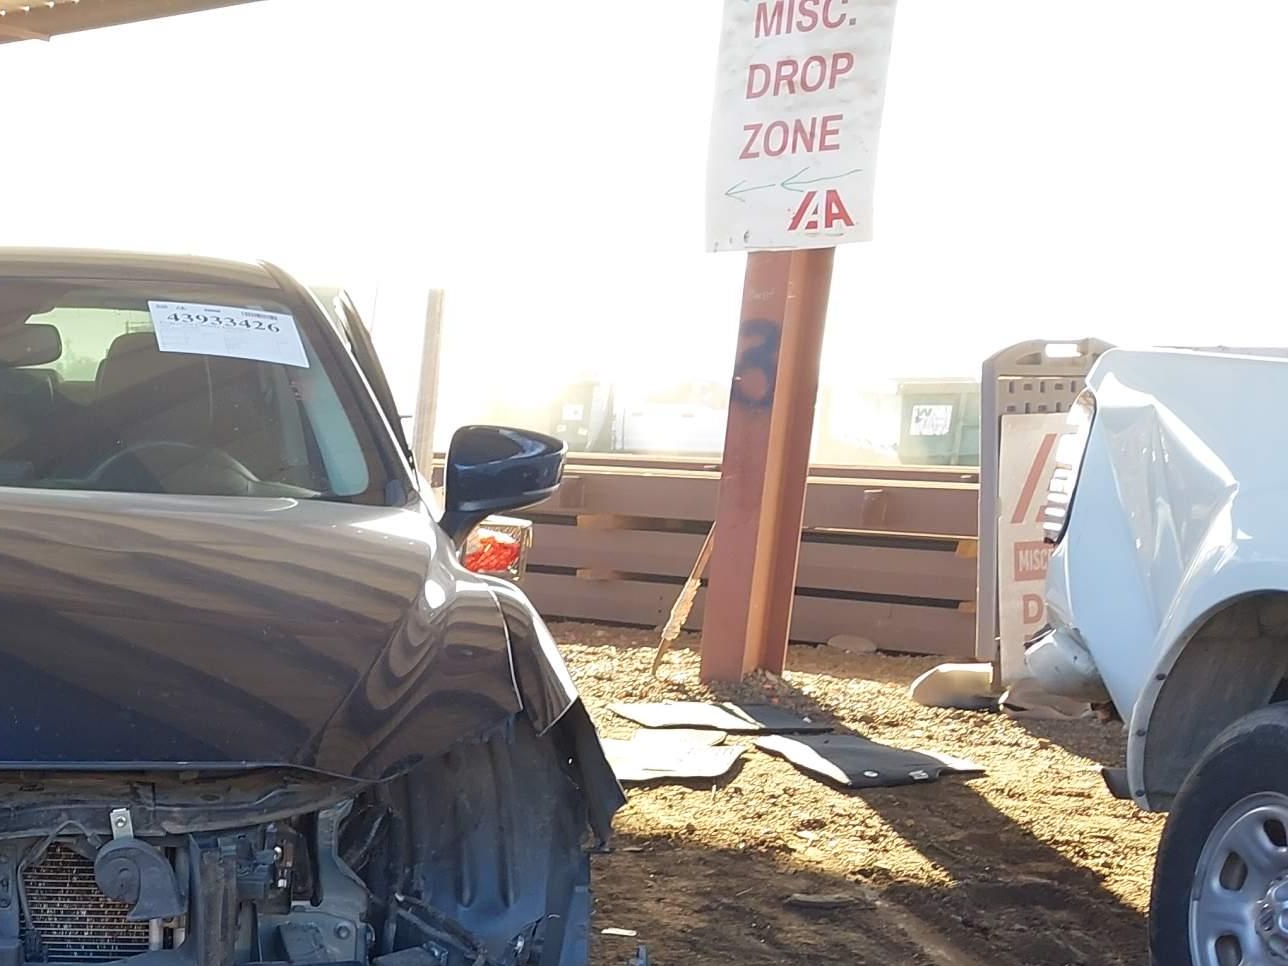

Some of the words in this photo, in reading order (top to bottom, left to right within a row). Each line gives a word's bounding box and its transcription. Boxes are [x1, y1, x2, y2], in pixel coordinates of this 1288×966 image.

[754, 0, 856, 38] MISC.
[746, 52, 854, 100] DROP
[739, 114, 843, 160] ZONE
[167, 312, 280, 333] 43933426
